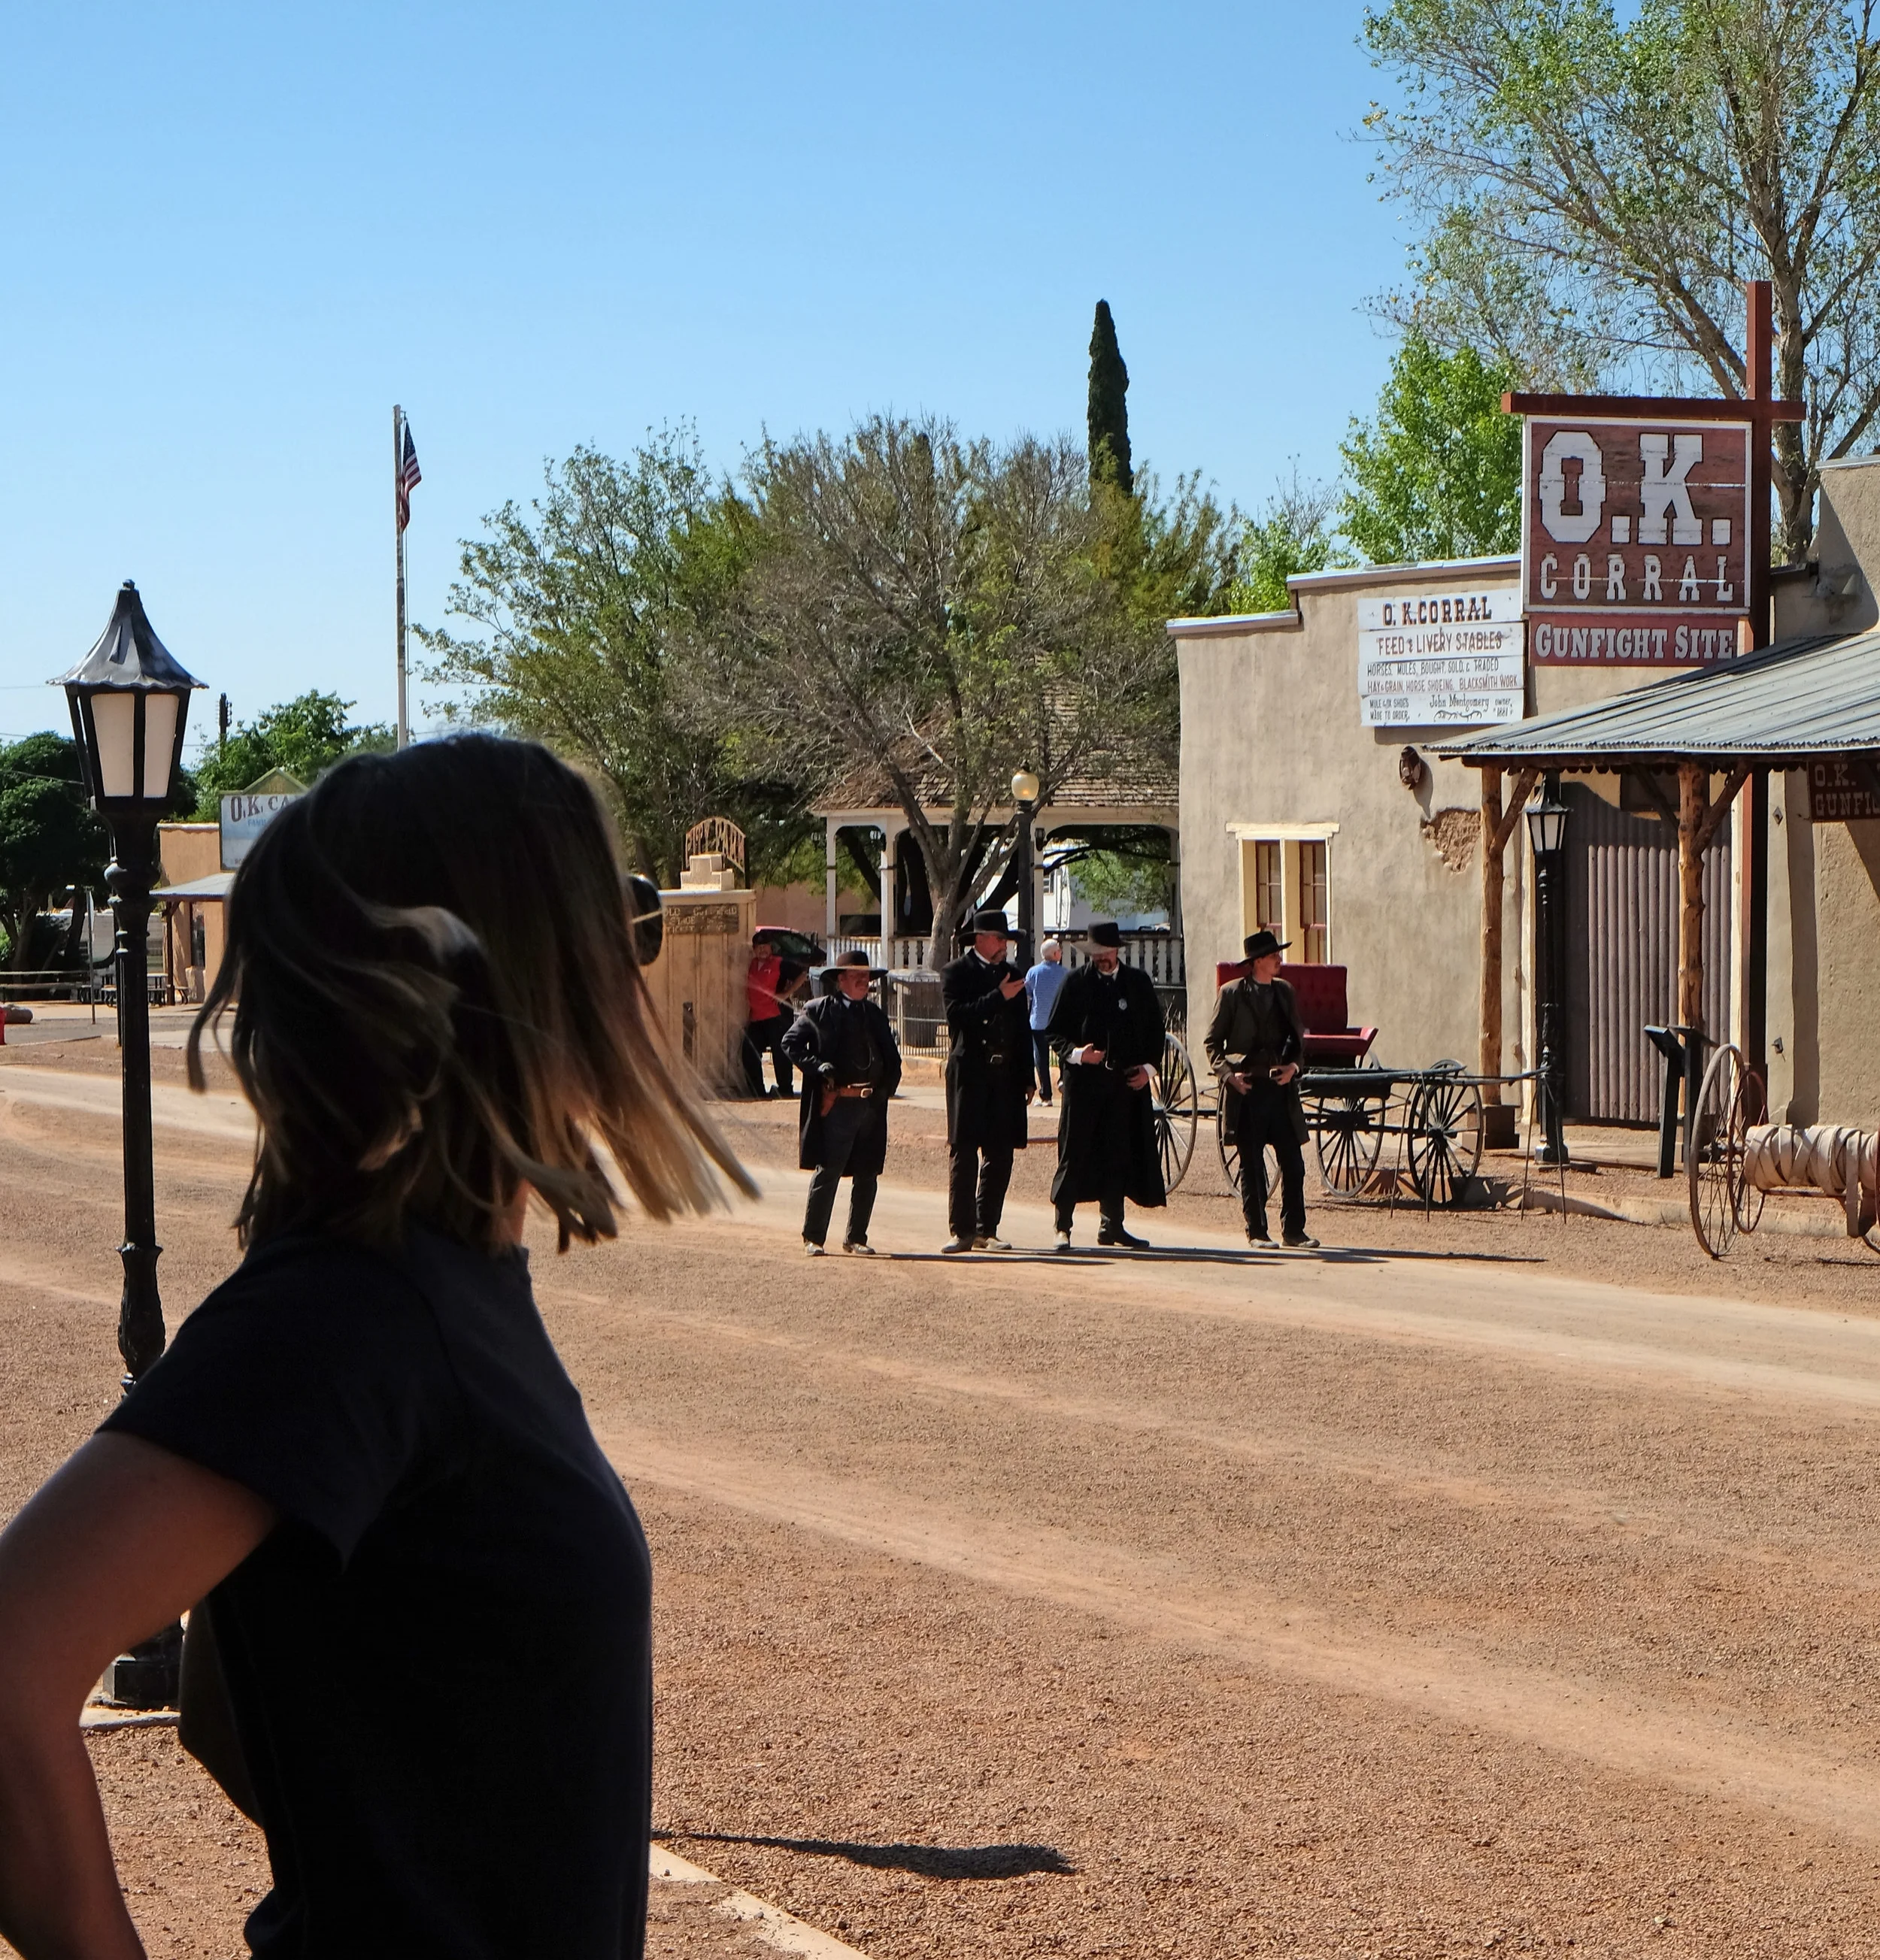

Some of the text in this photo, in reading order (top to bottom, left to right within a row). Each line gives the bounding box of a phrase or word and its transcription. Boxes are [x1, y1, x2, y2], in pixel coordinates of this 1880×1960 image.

[1538, 430, 1731, 546] O.K.
[1540, 553, 1733, 601] CORRAL
[1378, 636, 1404, 656] FEED
[1417, 632, 1452, 653] LIVERY
[1457, 631, 1502, 651] STABLES
[1535, 623, 1733, 659] GUNFIGHT SITE
[1474, 658, 1499, 671] TRADED
[1406, 680, 1425, 692] HORSE
[1460, 675, 1498, 690] BLACKSMITH
[1500, 674, 1518, 687] WORK
[1430, 695, 1446, 707] John
[1449, 693, 1489, 712] Montgomery
[1815, 764, 1857, 787] O.K.
